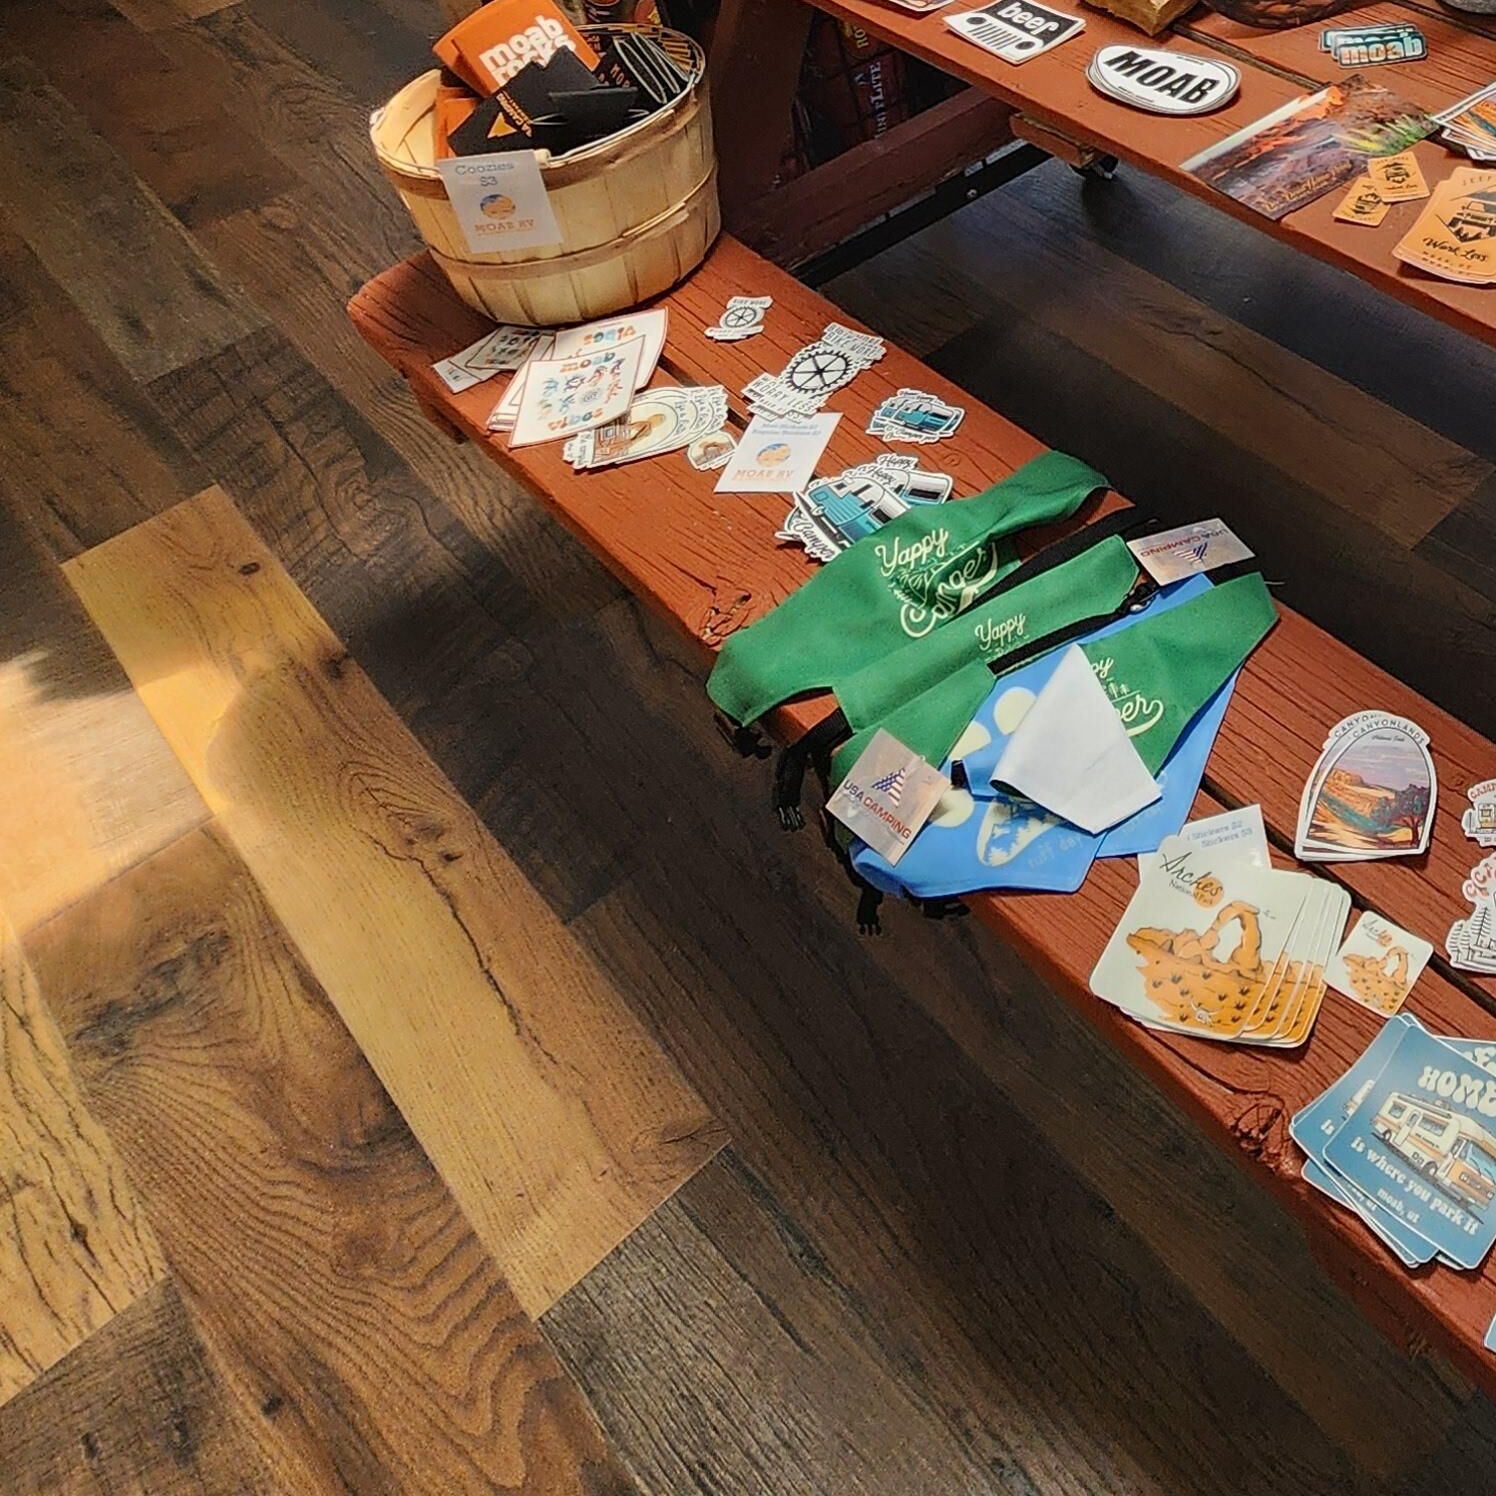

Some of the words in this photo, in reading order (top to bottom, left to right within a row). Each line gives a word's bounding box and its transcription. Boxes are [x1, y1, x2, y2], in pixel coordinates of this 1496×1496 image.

[997, 0, 1059, 36] beer
[479, 15, 565, 72] moab
[1340, 34, 1427, 66] moab
[1104, 51, 1220, 105] MOAB
[559, 352, 617, 374] moab
[875, 526, 950, 577] Yappy
[1139, 536, 1201, 558] CAMPING
[974, 611, 1027, 651] Yappy
[1352, 718, 1426, 745] CANYONLANDS
[843, 778, 866, 804] USA
[861, 795, 913, 841] CAMPING
[1159, 851, 1224, 898] Arches
[1351, 1136, 1367, 1154] is
[1366, 1149, 1405, 1184] where
[1406, 1178, 1430, 1204] you
[1429, 1196, 1464, 1226] park
